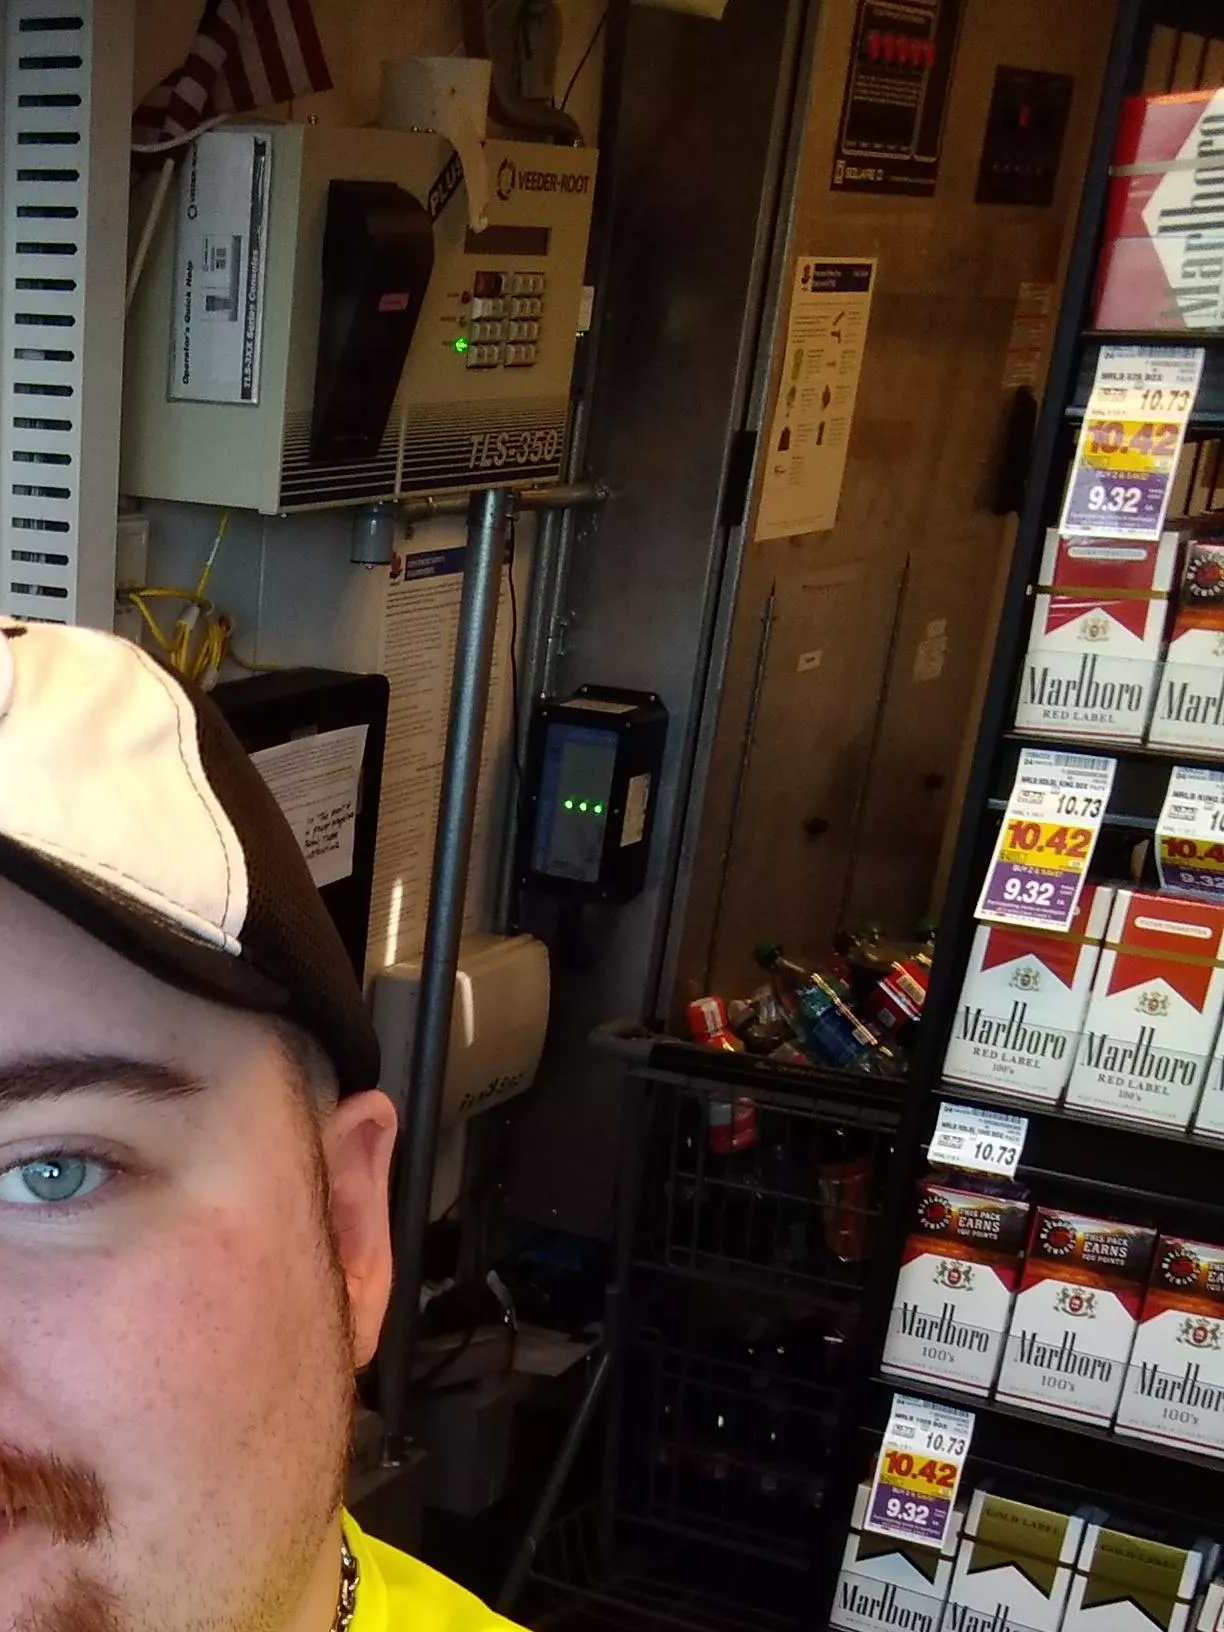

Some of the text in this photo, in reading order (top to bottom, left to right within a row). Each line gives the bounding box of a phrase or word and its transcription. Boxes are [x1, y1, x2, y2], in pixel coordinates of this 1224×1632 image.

[519, 170, 590, 193] VEEDER-ROOT
[182, 260, 194, 385] Operator's Quick Help
[246, 310, 256, 341] Series
[1140, 388, 1191, 412] 10.73
[469, 429, 556, 469] TLS-350
[1087, 420, 1180, 456] 10.42
[1087, 485, 1142, 513] 9.32
[1022, 652, 1144, 712] Marlboro
[1042, 708, 1115, 724] RED LABEL
[1056, 794, 1102, 819] 10.73
[1008, 820, 1093, 858] 10.42
[1003, 878, 1055, 906] 9.32
[955, 1000, 1067, 1061] Marlboro
[972, 1047, 1042, 1069] RED LABEL
[1080, 1025, 1198, 1087] Marlboro
[1097, 1073, 1170, 1097] RED LABEL
[974, 1141, 1017, 1166] 10.73
[958, 1217, 1001, 1233] EARNS
[959, 1207, 1001, 1223] THIS PACK
[972, 1229, 999, 1241] POINTS
[1084, 1232, 1128, 1248] THIS PACK
[1083, 1242, 1127, 1258] EARNS
[1097, 1255, 1125, 1267] POINTS
[897, 1302, 990, 1354] Marlboro
[921, 1346, 955, 1364] 100's
[1014, 1330, 1113, 1384] Marlboro
[1040, 1374, 1076, 1393] 100's
[1162, 1405, 1200, 1426] 100's
[926, 1432, 966, 1456] 10.73
[884, 1450, 958, 1489] 10.42
[886, 1497, 930, 1526] 9.32
